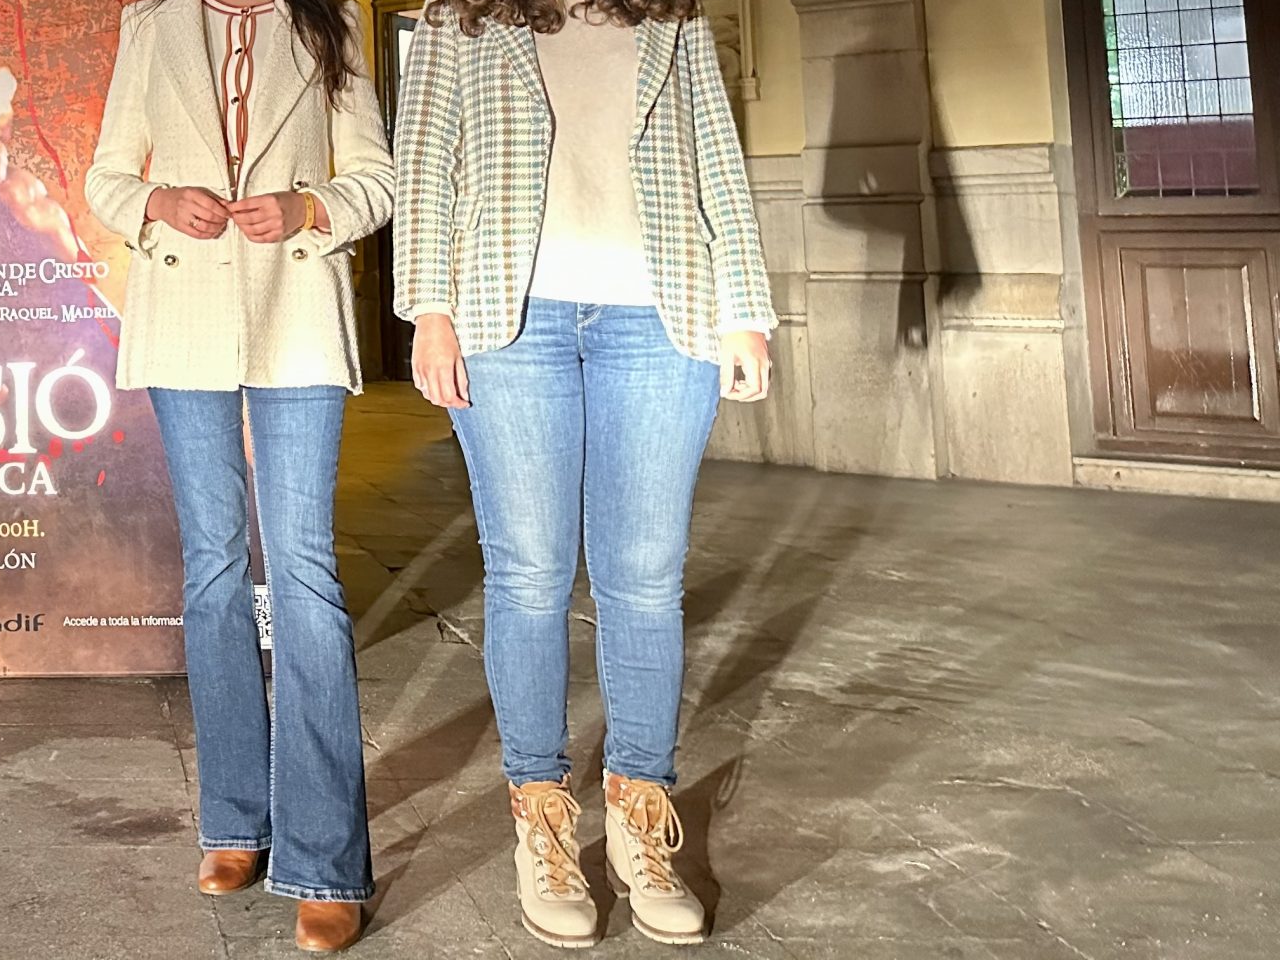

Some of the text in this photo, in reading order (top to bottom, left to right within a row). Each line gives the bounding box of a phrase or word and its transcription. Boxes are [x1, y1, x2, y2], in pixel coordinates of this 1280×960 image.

[9, 261, 37, 280] DE
[38, 258, 110, 284] CRISTO
[0, 304, 118, 323] RAQUEL, MADRID
[63, 614, 184, 628] Accede a toda la informaci
